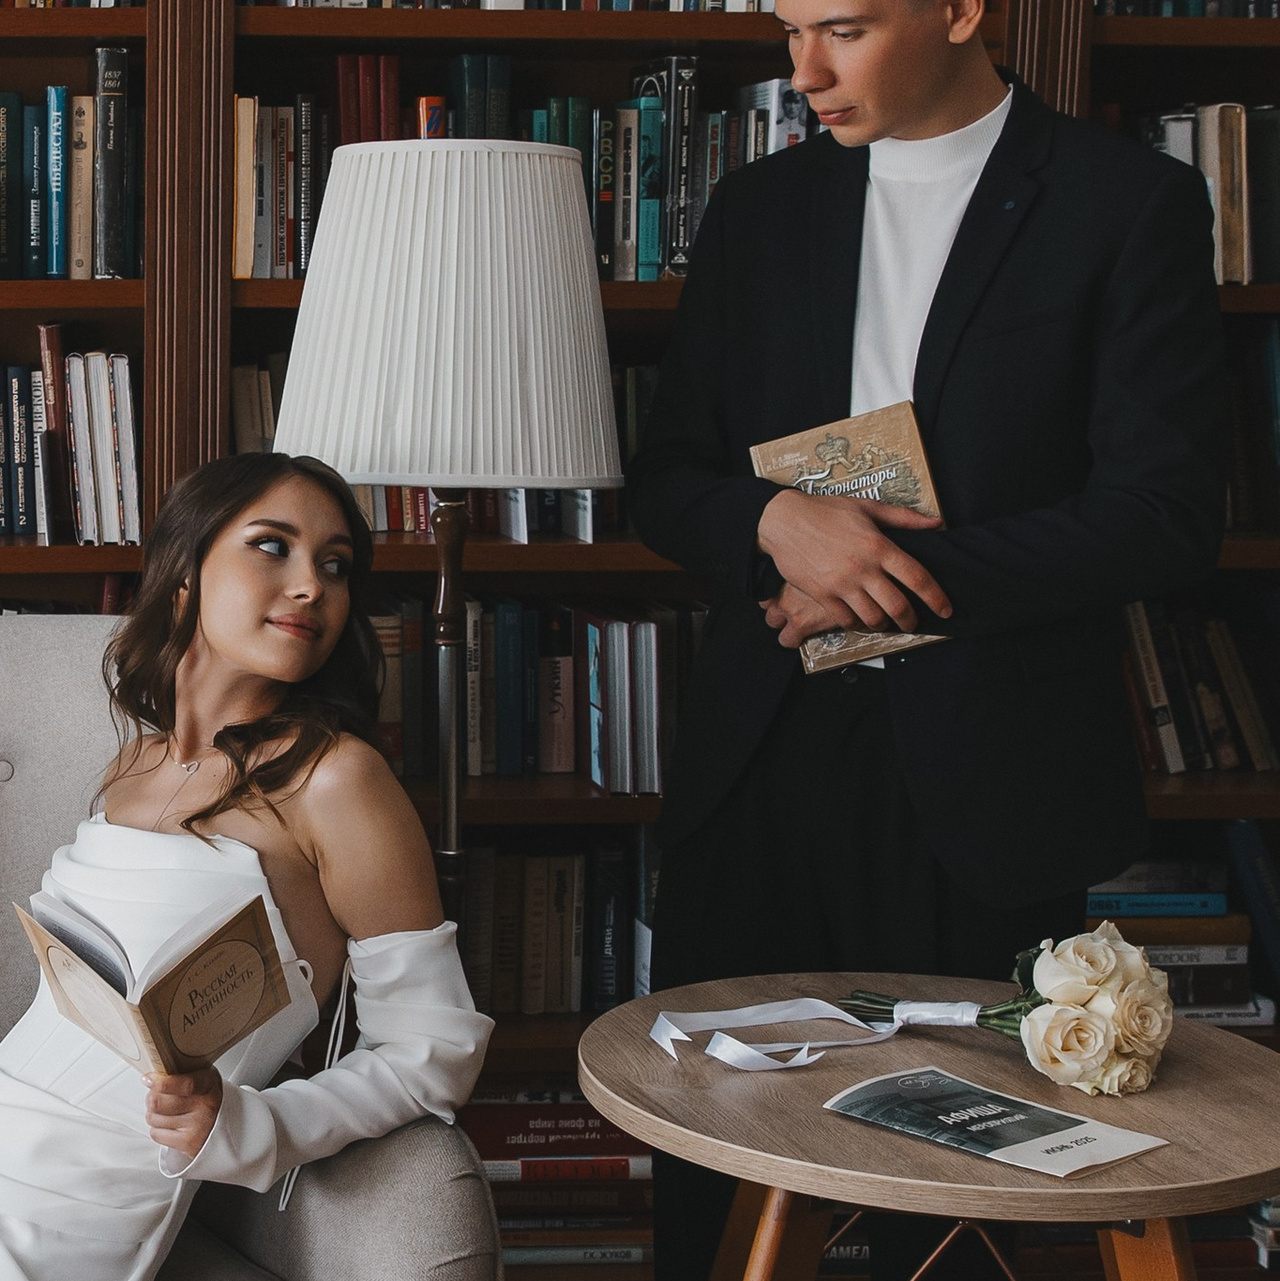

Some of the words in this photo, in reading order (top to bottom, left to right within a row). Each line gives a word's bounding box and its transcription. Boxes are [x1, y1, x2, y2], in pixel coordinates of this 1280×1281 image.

[182, 968, 254, 1033] АНТИЧНОСТЬ
[187, 964, 237, 1009] РУССКАЯ
[936, 1103, 1010, 1126] АФИША
